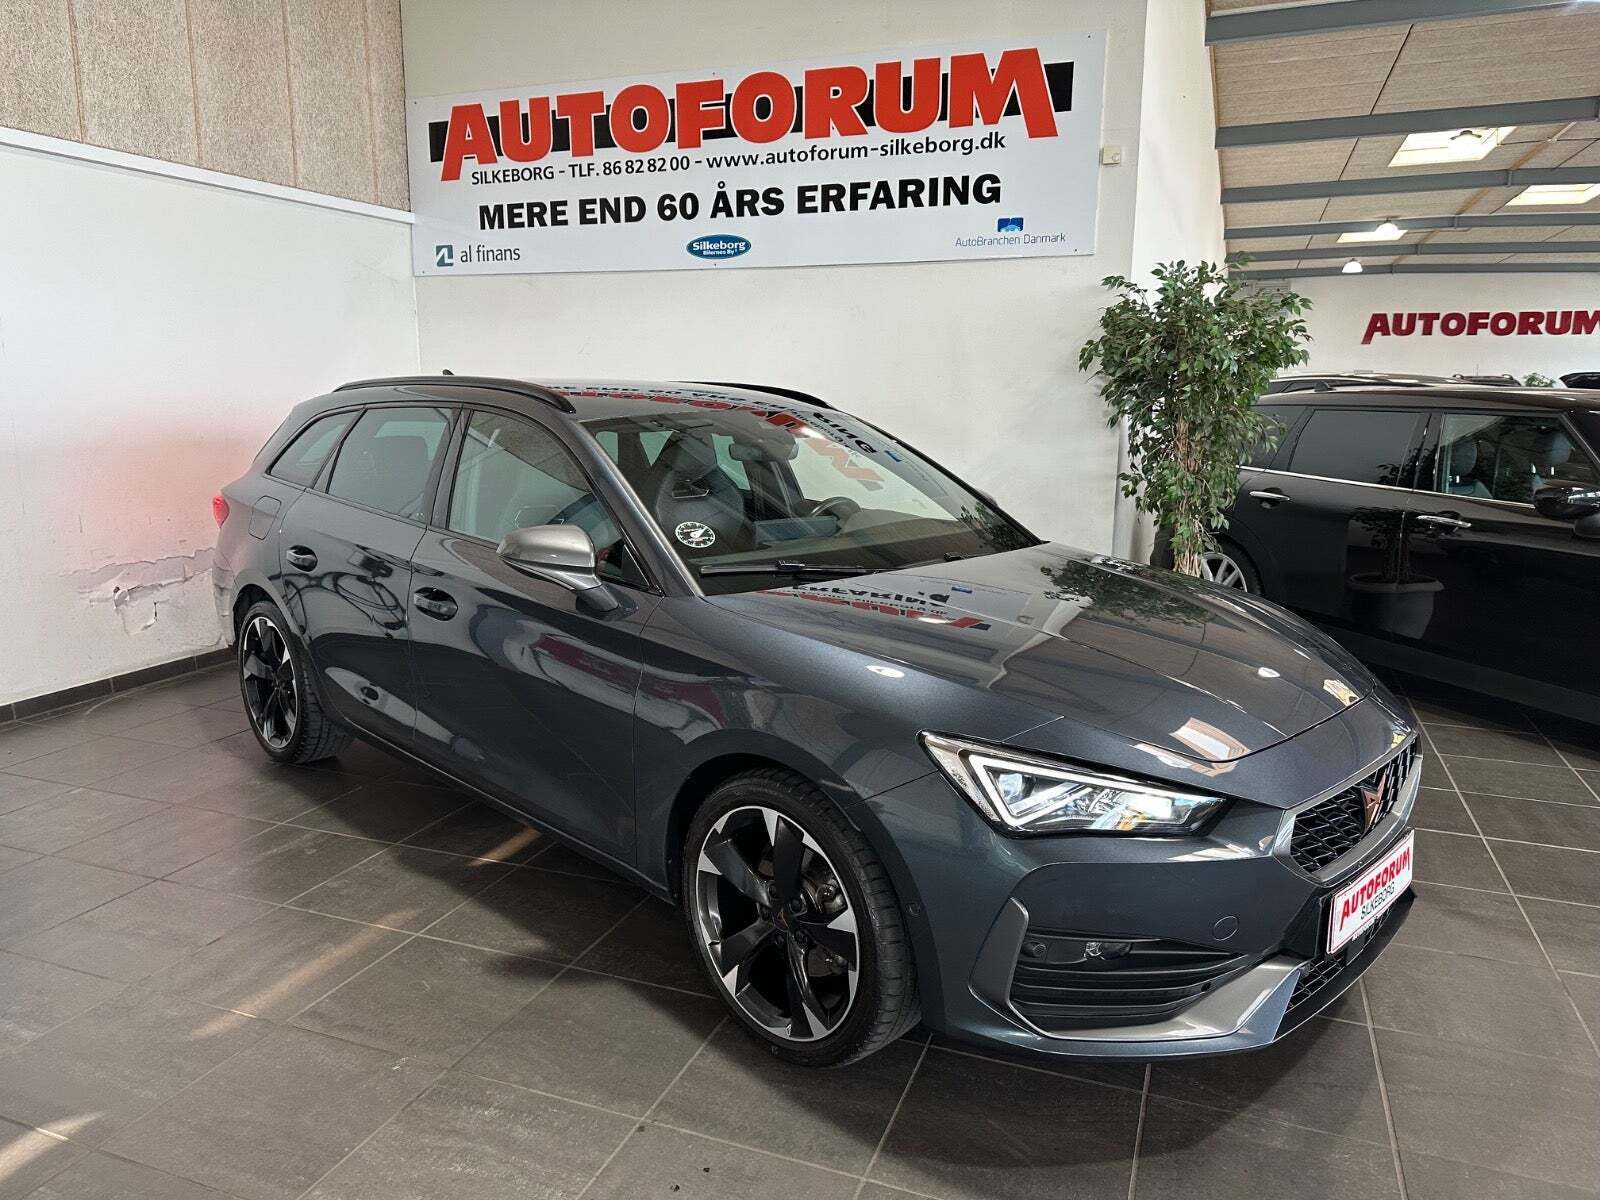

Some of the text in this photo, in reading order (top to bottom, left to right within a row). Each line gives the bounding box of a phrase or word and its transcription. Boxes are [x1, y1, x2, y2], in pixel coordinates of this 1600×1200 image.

[440, 47, 1059, 182] AUTOFORUM
[471, 165, 555, 185] SILKEBORG
[569, 162, 600, 178] TLF.
[706, 131, 1007, 169] www.autoforum-silkeborg.dk
[479, 173, 1001, 231] MERE END 60 ÅRS ERFARING
[460, 244, 521, 263] al finans
[692, 240, 746, 251] Silkeborg
[955, 232, 1066, 247] AutoBranchen Danmark
[1339, 847, 1410, 932] AUTOFORUM
[1360, 881, 1395, 920] SILKEBORG
